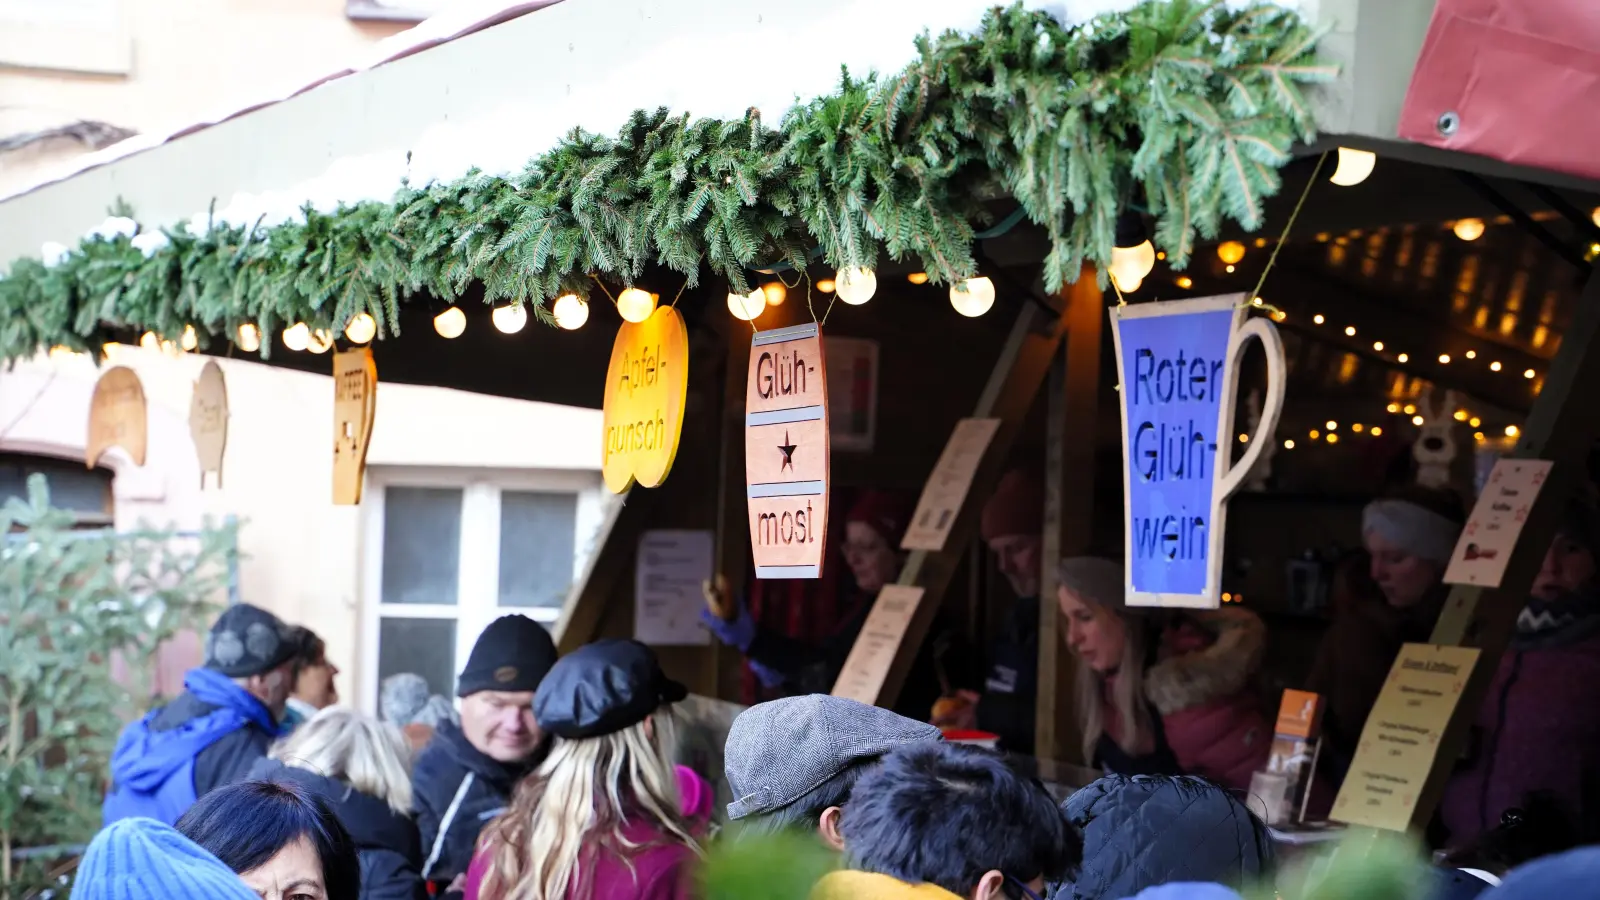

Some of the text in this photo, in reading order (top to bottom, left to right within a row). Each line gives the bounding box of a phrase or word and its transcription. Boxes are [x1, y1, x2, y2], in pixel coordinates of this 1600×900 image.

[618, 344, 666, 397] Apfel-
[757, 350, 814, 399] Glüh-
[1134, 348, 1223, 405] Roter
[605, 409, 664, 465] punsch
[1134, 420, 1217, 483] Glüh-
[758, 499, 813, 545] most
[1134, 505, 1205, 562] wein
